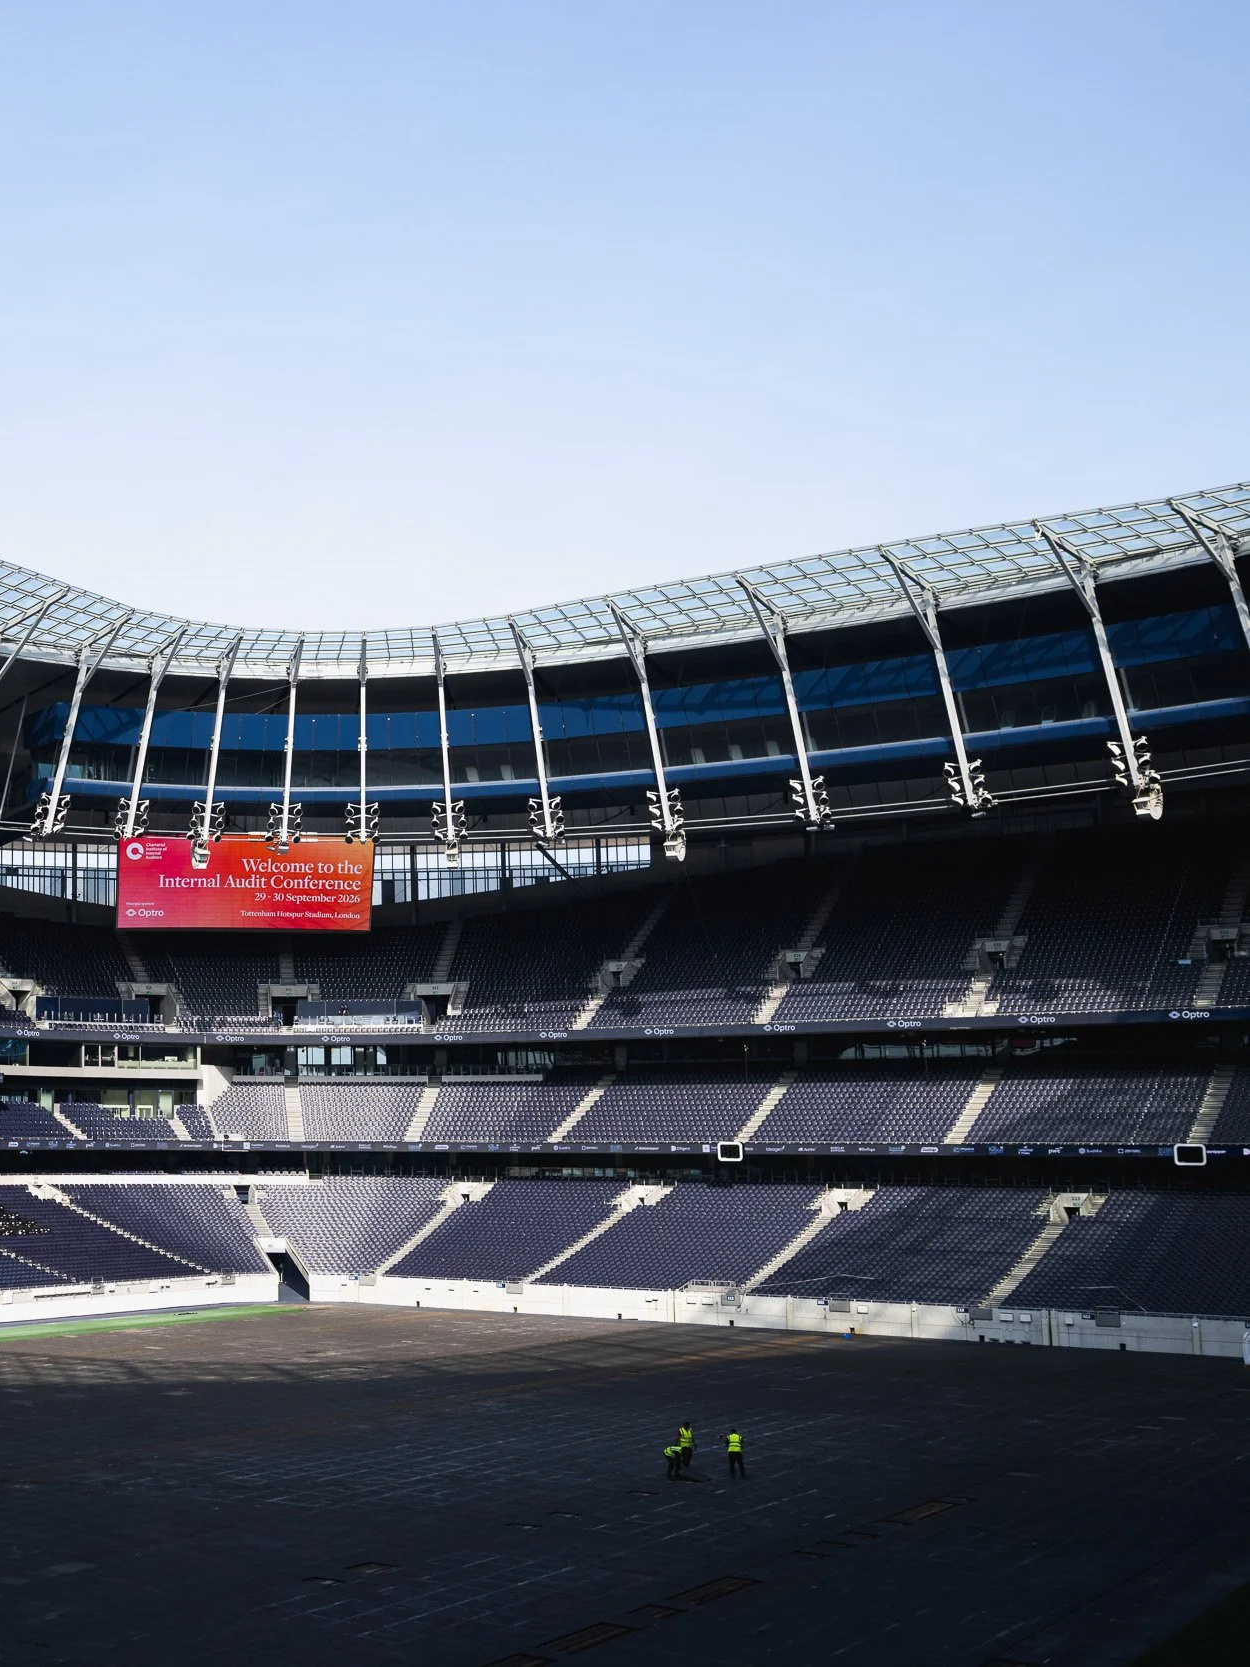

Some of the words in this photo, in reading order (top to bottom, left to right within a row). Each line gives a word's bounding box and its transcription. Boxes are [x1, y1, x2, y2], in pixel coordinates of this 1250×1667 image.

[242, 858, 314, 875] Welcome
[318, 863, 334, 873] to
[339, 860, 362, 874] the
[159, 874, 220, 887] Internal
[224, 875, 267, 888] Audit
[271, 875, 361, 890] Conference
[273, 893, 284, 901] 30
[286, 893, 336, 904] September
[138, 909, 164, 918] Optro
[277, 911, 303, 919] Hotspur
[1182, 1009, 1210, 1021] Optro
[897, 1019, 922, 1028] Optro
[1029, 1015, 1056, 1025] Optro
[653, 1027, 675, 1037] Optro
[773, 1023, 795, 1033] Optro
[23, 1029, 40, 1038] Optro
[121, 1033, 140, 1041] Optro
[548, 1030, 568, 1040] Optro
[225, 1035, 245, 1043] Optro
[330, 1035, 352, 1043] Optro
[443, 1034, 463, 1043] Optro
